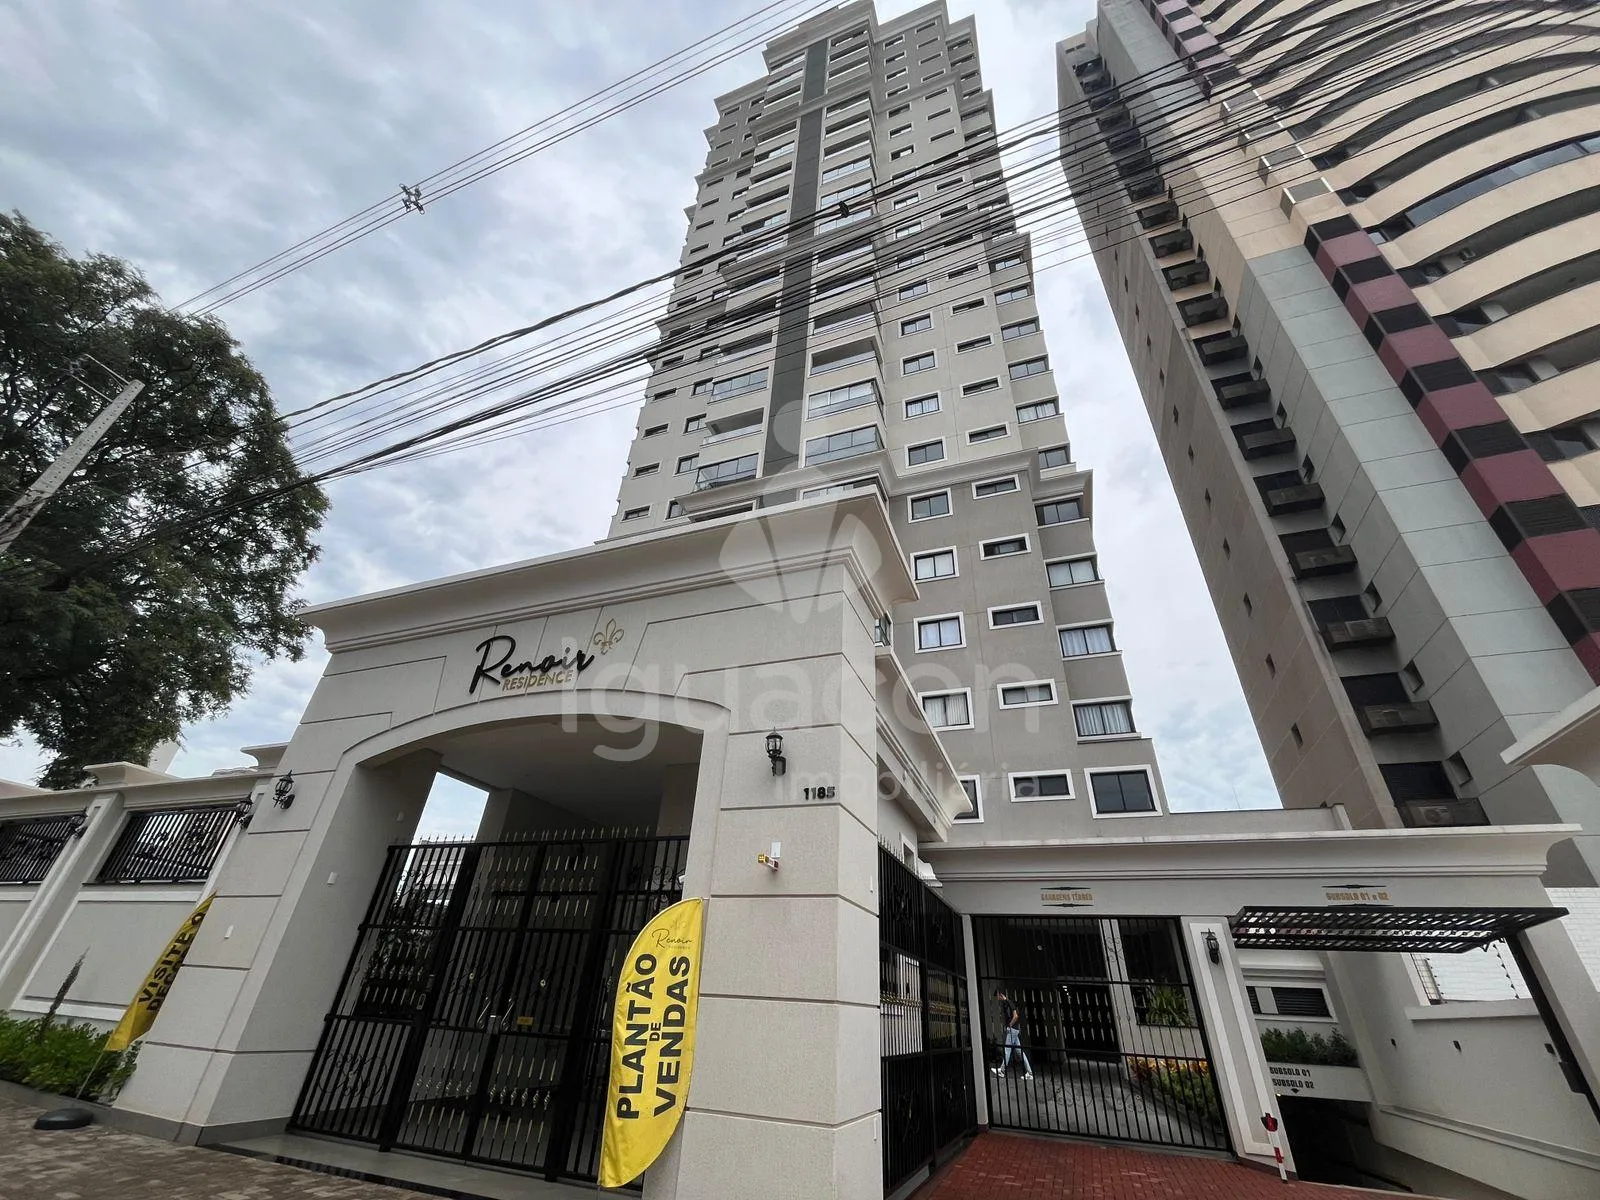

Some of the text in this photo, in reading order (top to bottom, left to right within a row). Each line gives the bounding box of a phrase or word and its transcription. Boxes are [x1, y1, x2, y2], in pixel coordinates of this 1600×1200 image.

[468, 635, 595, 695] Renoir
[502, 669, 574, 692] RESIDENCE
[803, 786, 836, 801] 1185
[616, 953, 657, 1119] PLANTÃO
[649, 1022, 662, 1042] DE
[653, 956, 690, 1117] VENDAS
[1269, 1066, 1311, 1077] SUBSOLO 01
[1272, 1078, 1315, 1089] SUBSOLO 02
